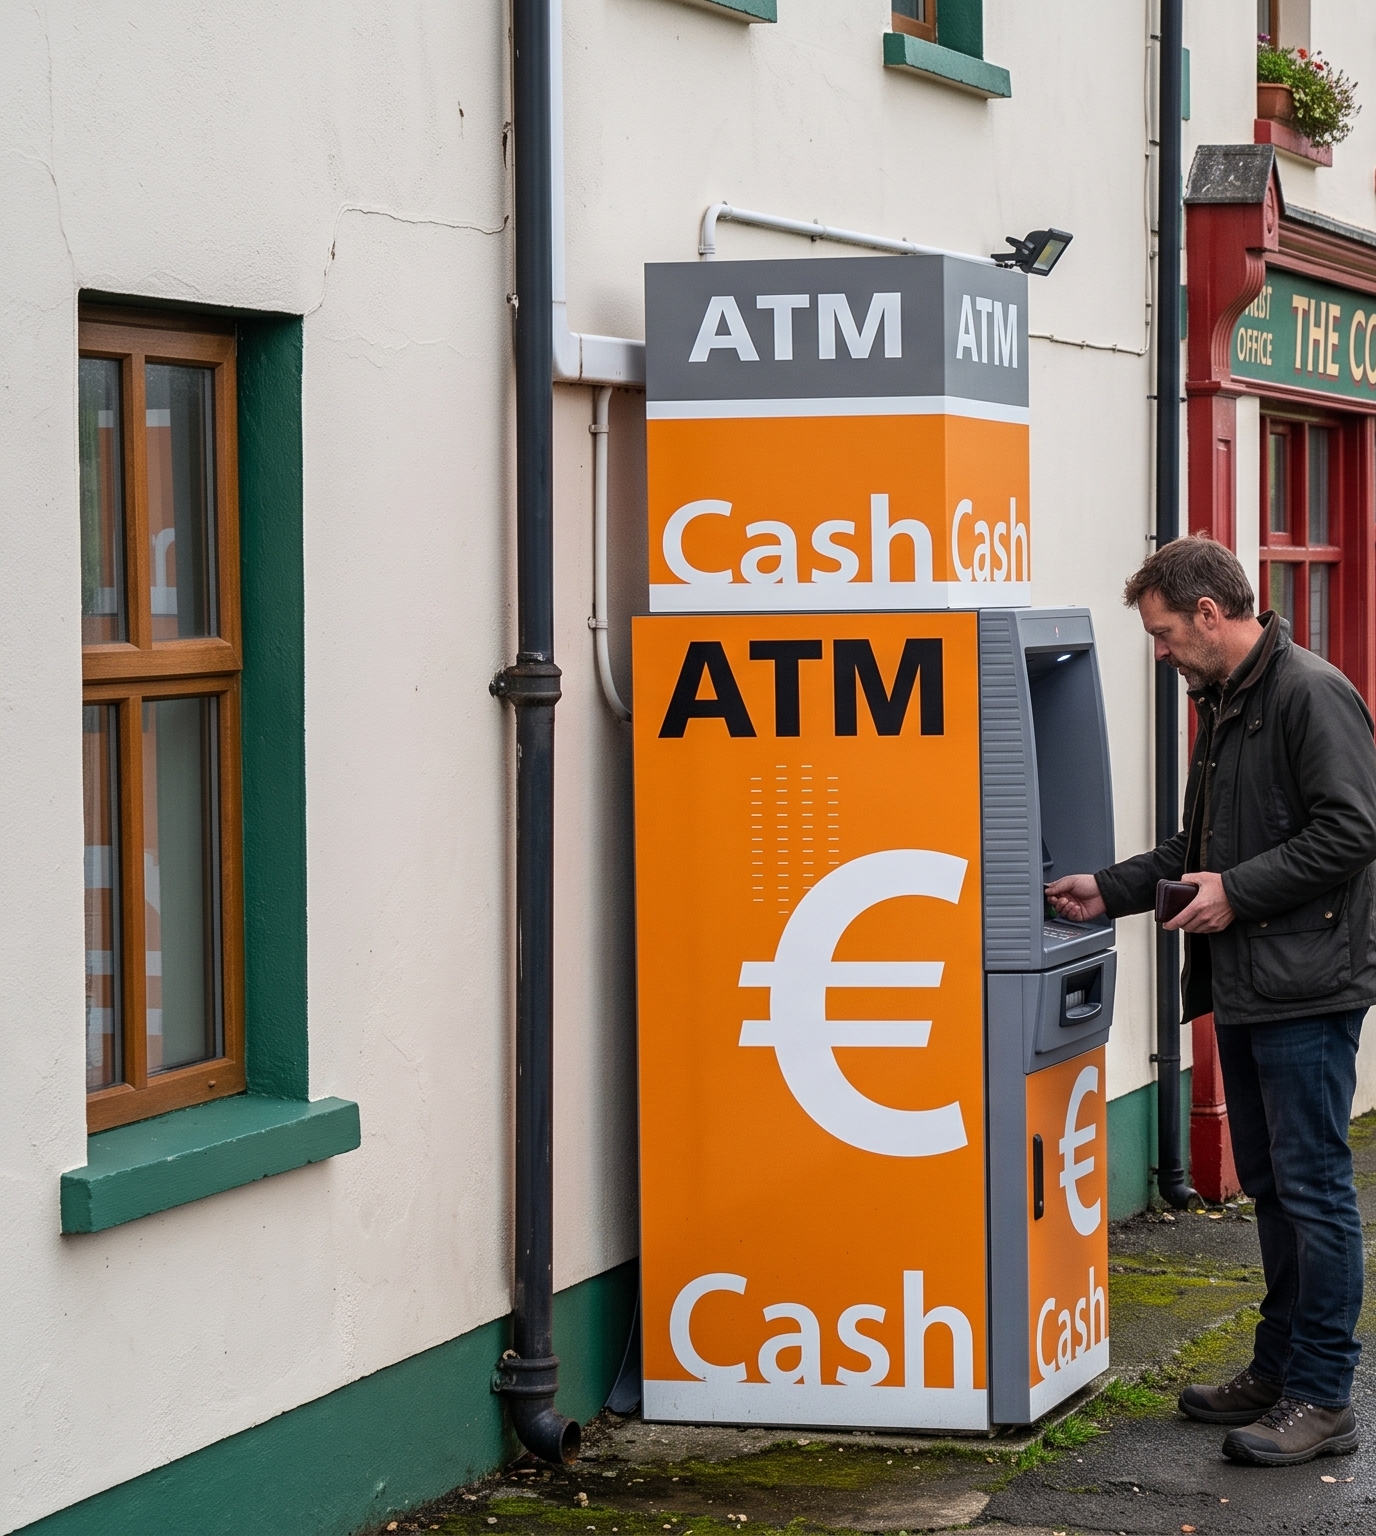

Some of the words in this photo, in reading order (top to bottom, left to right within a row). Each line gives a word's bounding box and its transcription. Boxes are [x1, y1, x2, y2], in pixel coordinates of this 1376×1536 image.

[688, 292, 902, 362] ATM
[956, 294, 1018, 368] ATM
[1237, 327, 1273, 366] OFFICE
[1292, 294, 1341, 377] THE
[662, 494, 934, 584] Cash
[951, 496, 1028, 582] Cash
[658, 638, 945, 738] ATM
[738, 849, 968, 1157] €
[669, 1270, 974, 1390] Cash
[1036, 1266, 1107, 1373] Cash
